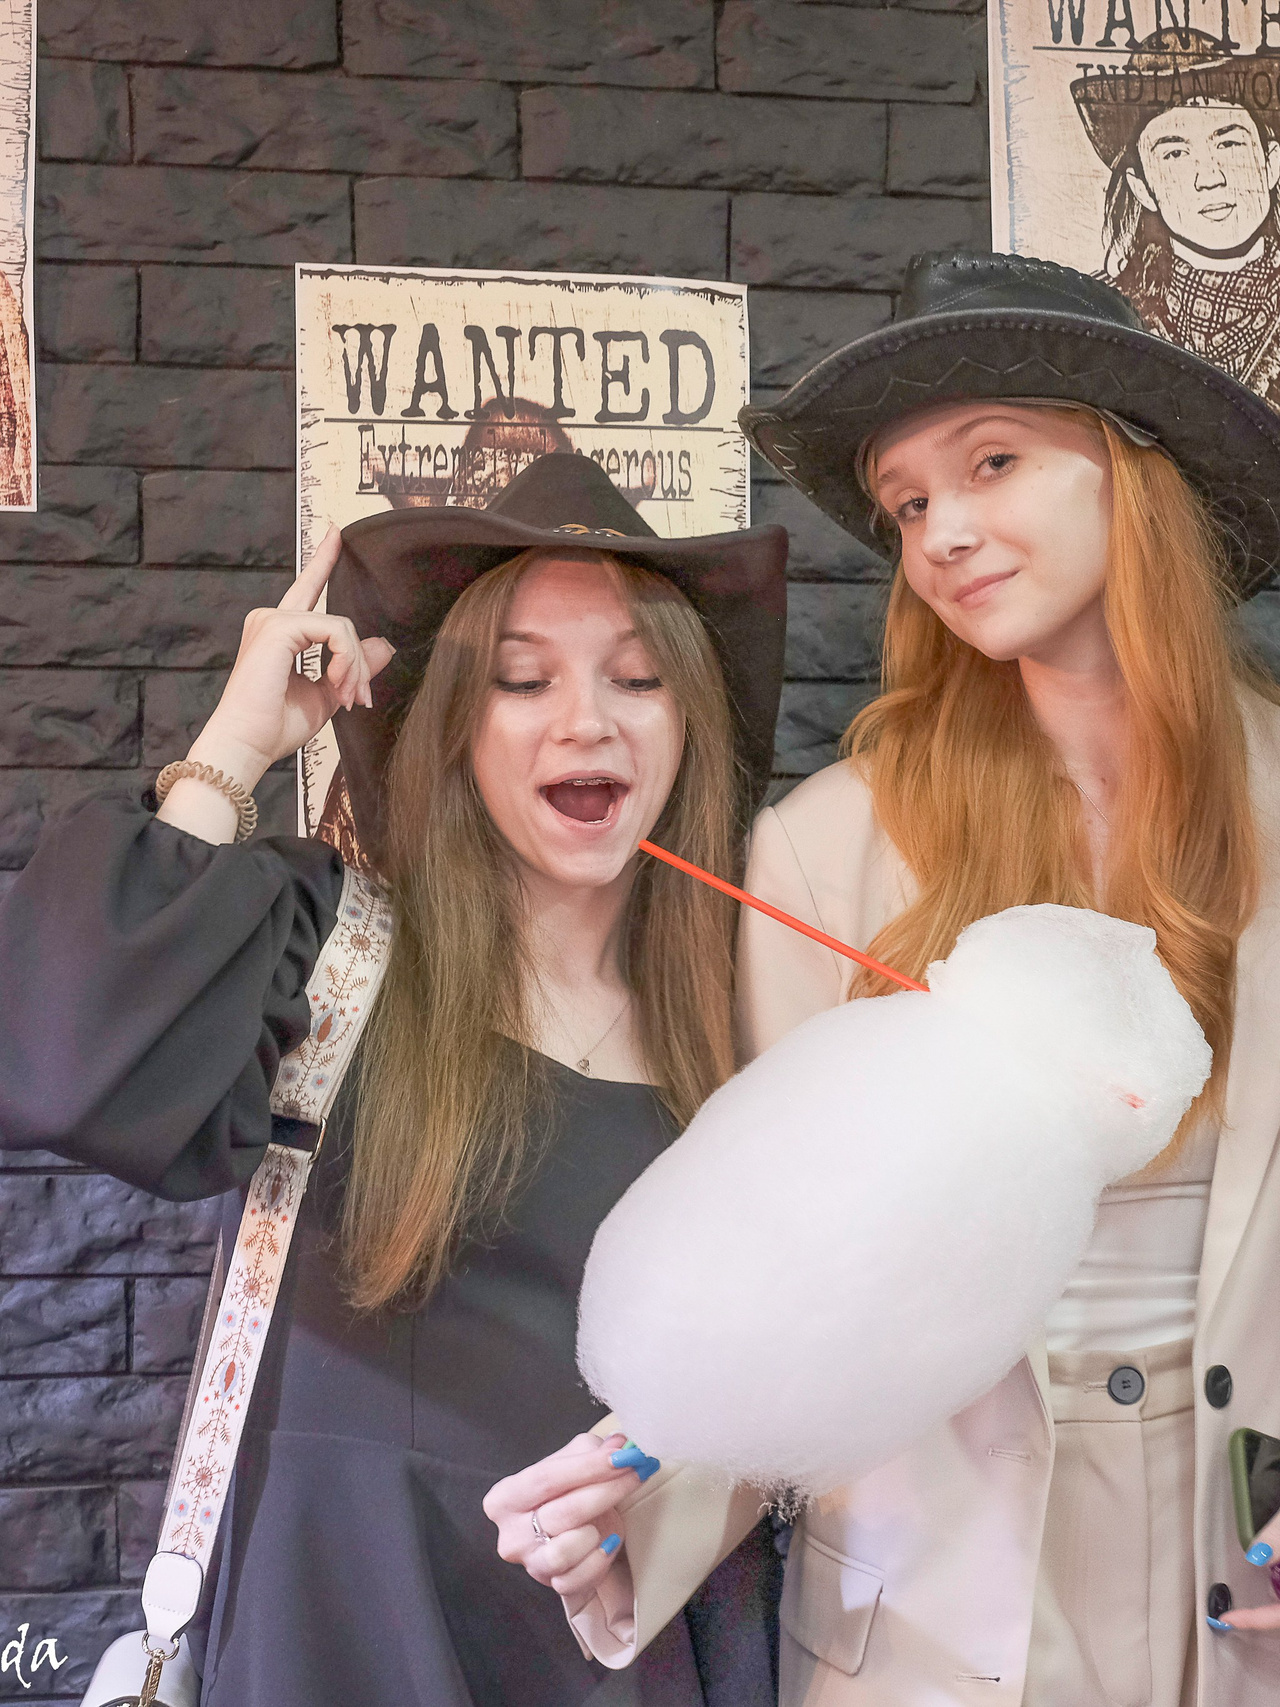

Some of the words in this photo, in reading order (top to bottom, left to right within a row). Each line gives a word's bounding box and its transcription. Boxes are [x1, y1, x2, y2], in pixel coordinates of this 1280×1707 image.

[1076, 63, 1210, 106] INDIAN
[332, 323, 716, 424] WANTED
[534, 429, 692, 499] erous
